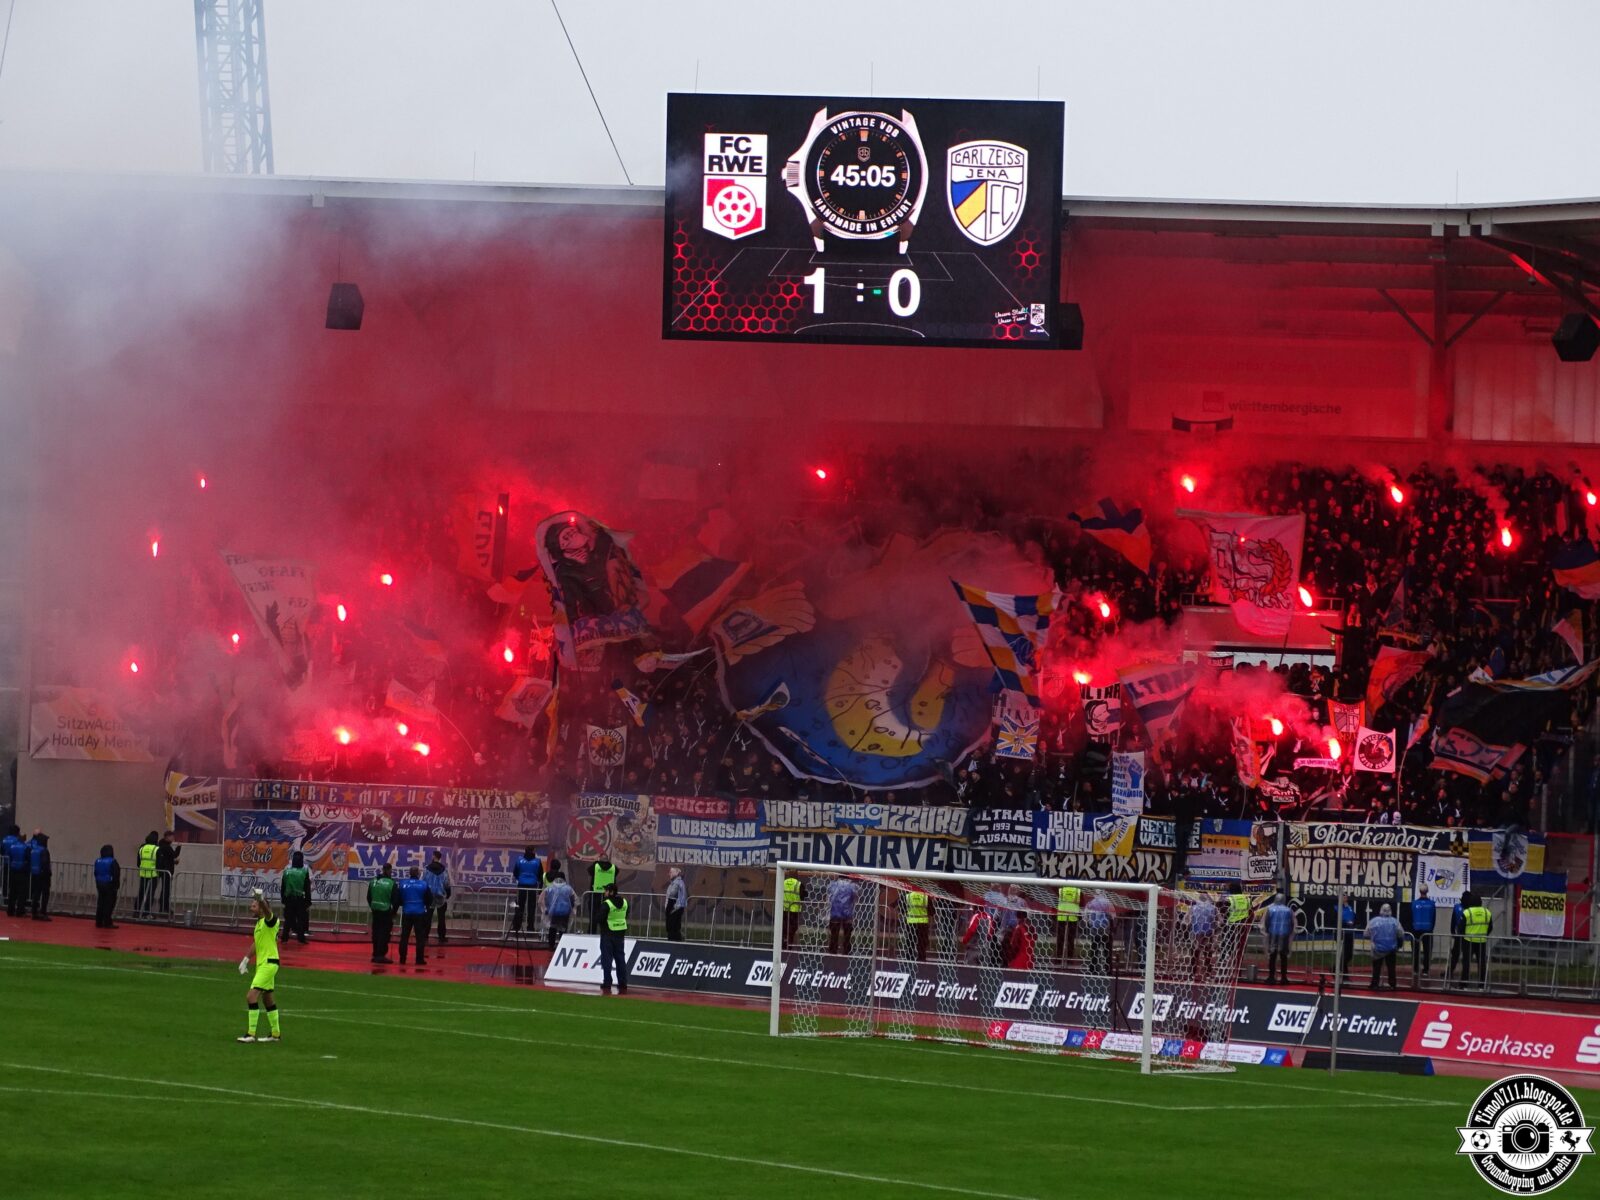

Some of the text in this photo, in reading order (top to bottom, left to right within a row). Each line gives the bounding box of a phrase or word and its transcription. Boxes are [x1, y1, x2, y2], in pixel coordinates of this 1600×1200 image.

[830, 117, 876, 135] VINTAGE
[719, 135, 751, 153] FC
[707, 154, 763, 173] RWE
[954, 147, 1021, 166] CARL ZEISS
[830, 164, 896, 188] 45:05
[965, 168, 1009, 180] JENA
[814, 198, 913, 232] HANDMADE IN ERFURT
[803, 267, 826, 313] 1
[887, 268, 921, 316] 0
[1228, 400, 1342, 415] württembergische
[670, 818, 756, 838] UNBEUGSAM
[657, 847, 769, 867] UNVERKÄUFLICH
[767, 831, 949, 872] SÜDKURVE
[953, 851, 1036, 872] ULTRAS
[1288, 856, 1413, 887] WOLFPACK
[1303, 883, 1325, 895] FCC
[1521, 894, 1564, 911] EISENBERG
[636, 958, 666, 975] SWE
[670, 957, 694, 977] Für
[696, 960, 732, 980] Erfurt.
[788, 968, 811, 986] Für
[811, 970, 851, 990] Erfurt.
[875, 972, 902, 993] SWE
[911, 979, 937, 999] Für
[937, 981, 979, 1001] Erfurt.
[999, 988, 1034, 1004] SWE
[1040, 991, 1066, 1009] Für
[1066, 992, 1112, 1013] Erfurt.
[1176, 1001, 1202, 1020] Für
[1202, 1003, 1250, 1024] Erfurt.
[1274, 1009, 1309, 1029] SWE
[1349, 1014, 1399, 1037] Erfurt.
[1456, 1031, 1555, 1060] Sparkasse
